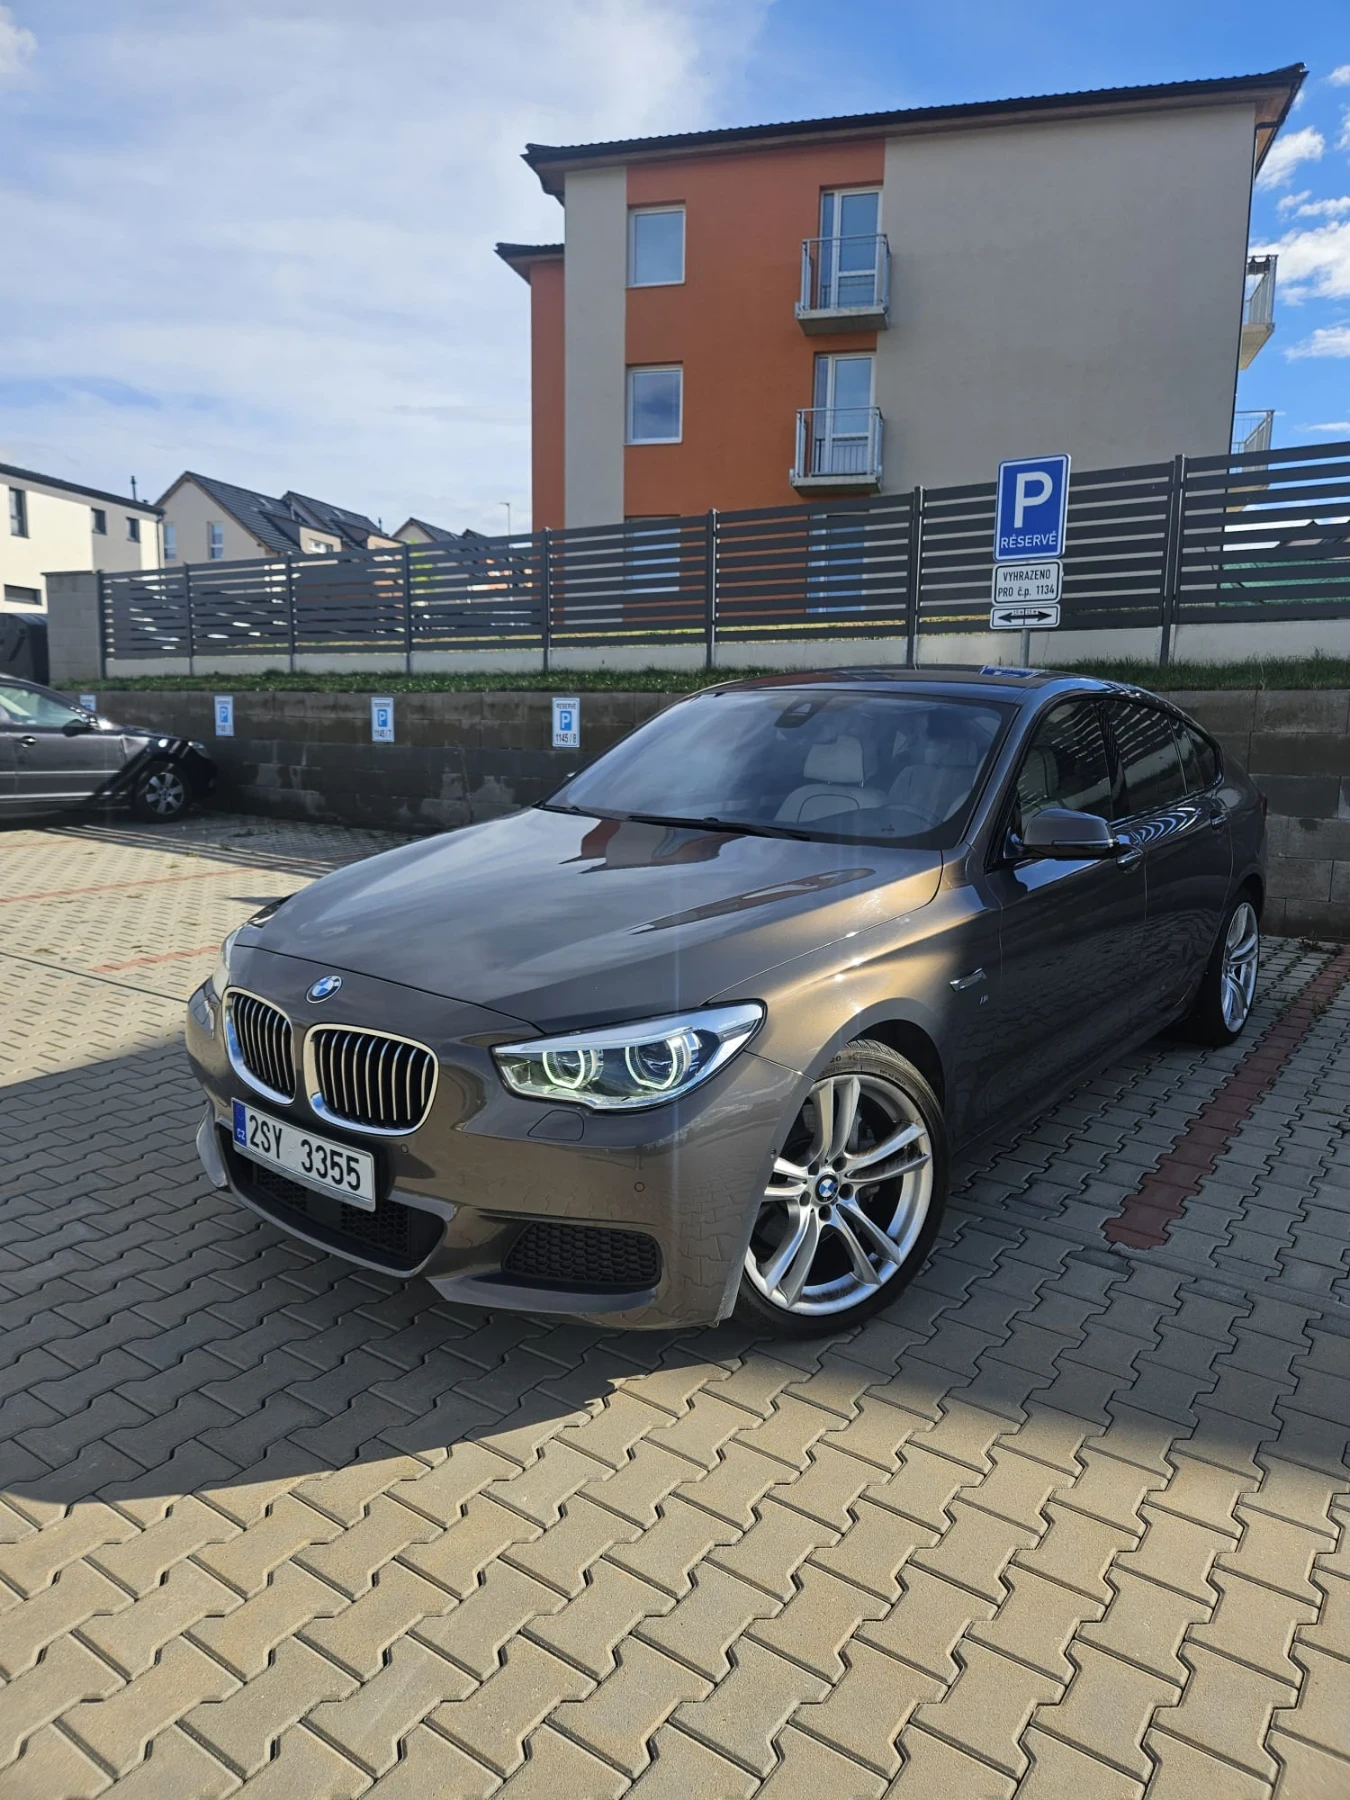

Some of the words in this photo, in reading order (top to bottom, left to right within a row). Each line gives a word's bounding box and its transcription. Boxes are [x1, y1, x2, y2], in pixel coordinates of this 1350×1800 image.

[1014, 471, 1053, 528] P
[1001, 530, 1057, 549] RÉSERVÉ
[1003, 569, 1051, 582] VYHRAZENO
[998, 587, 1013, 598] PRO
[1017, 587, 1031, 599] č.p.
[1036, 584, 1055, 596] 1134
[561, 713, 570, 729] P
[236, 1128, 246, 1141] CZ
[249, 1114, 283, 1159] 2SY
[301, 1139, 361, 1191] 3355
